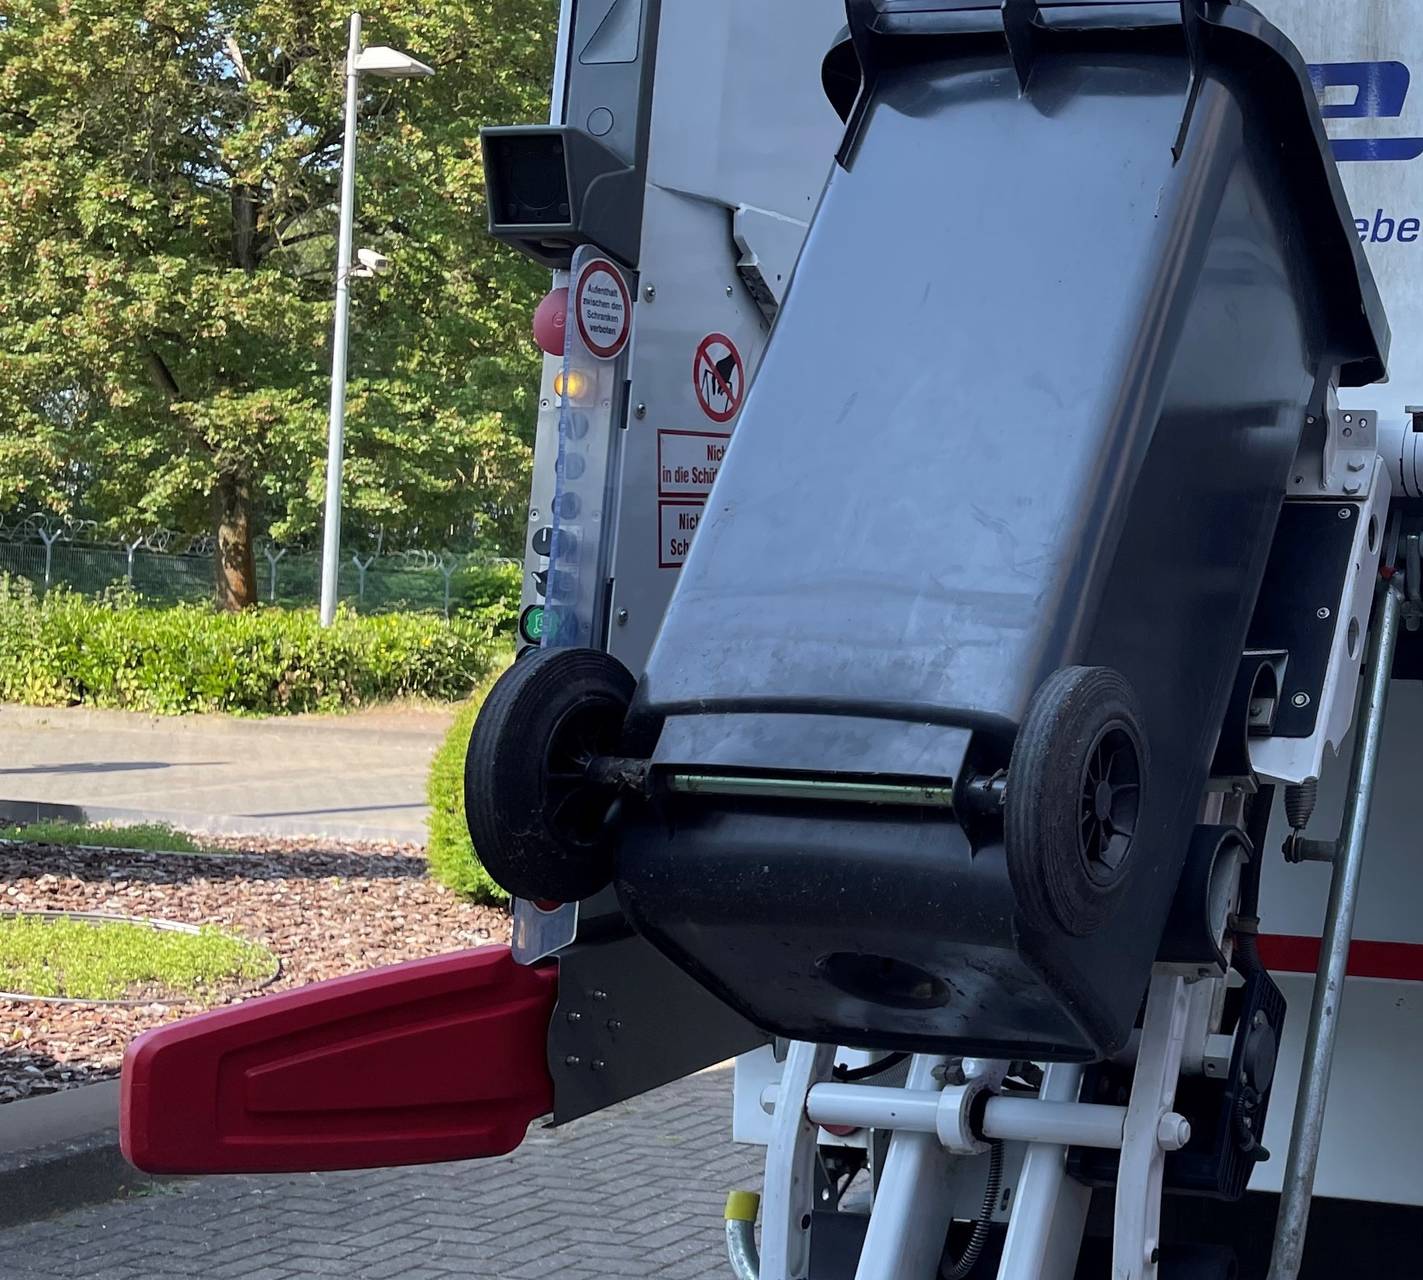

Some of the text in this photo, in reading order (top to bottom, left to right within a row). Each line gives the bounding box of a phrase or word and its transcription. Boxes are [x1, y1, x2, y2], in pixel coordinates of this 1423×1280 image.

[587, 284, 618, 298] Aufenthalt
[583, 298, 623, 311] zwischen den
[587, 310, 619, 324] Schranken
[589, 324, 617, 336] verboten
[662, 465, 672, 483] in
[674, 466, 690, 484] die
